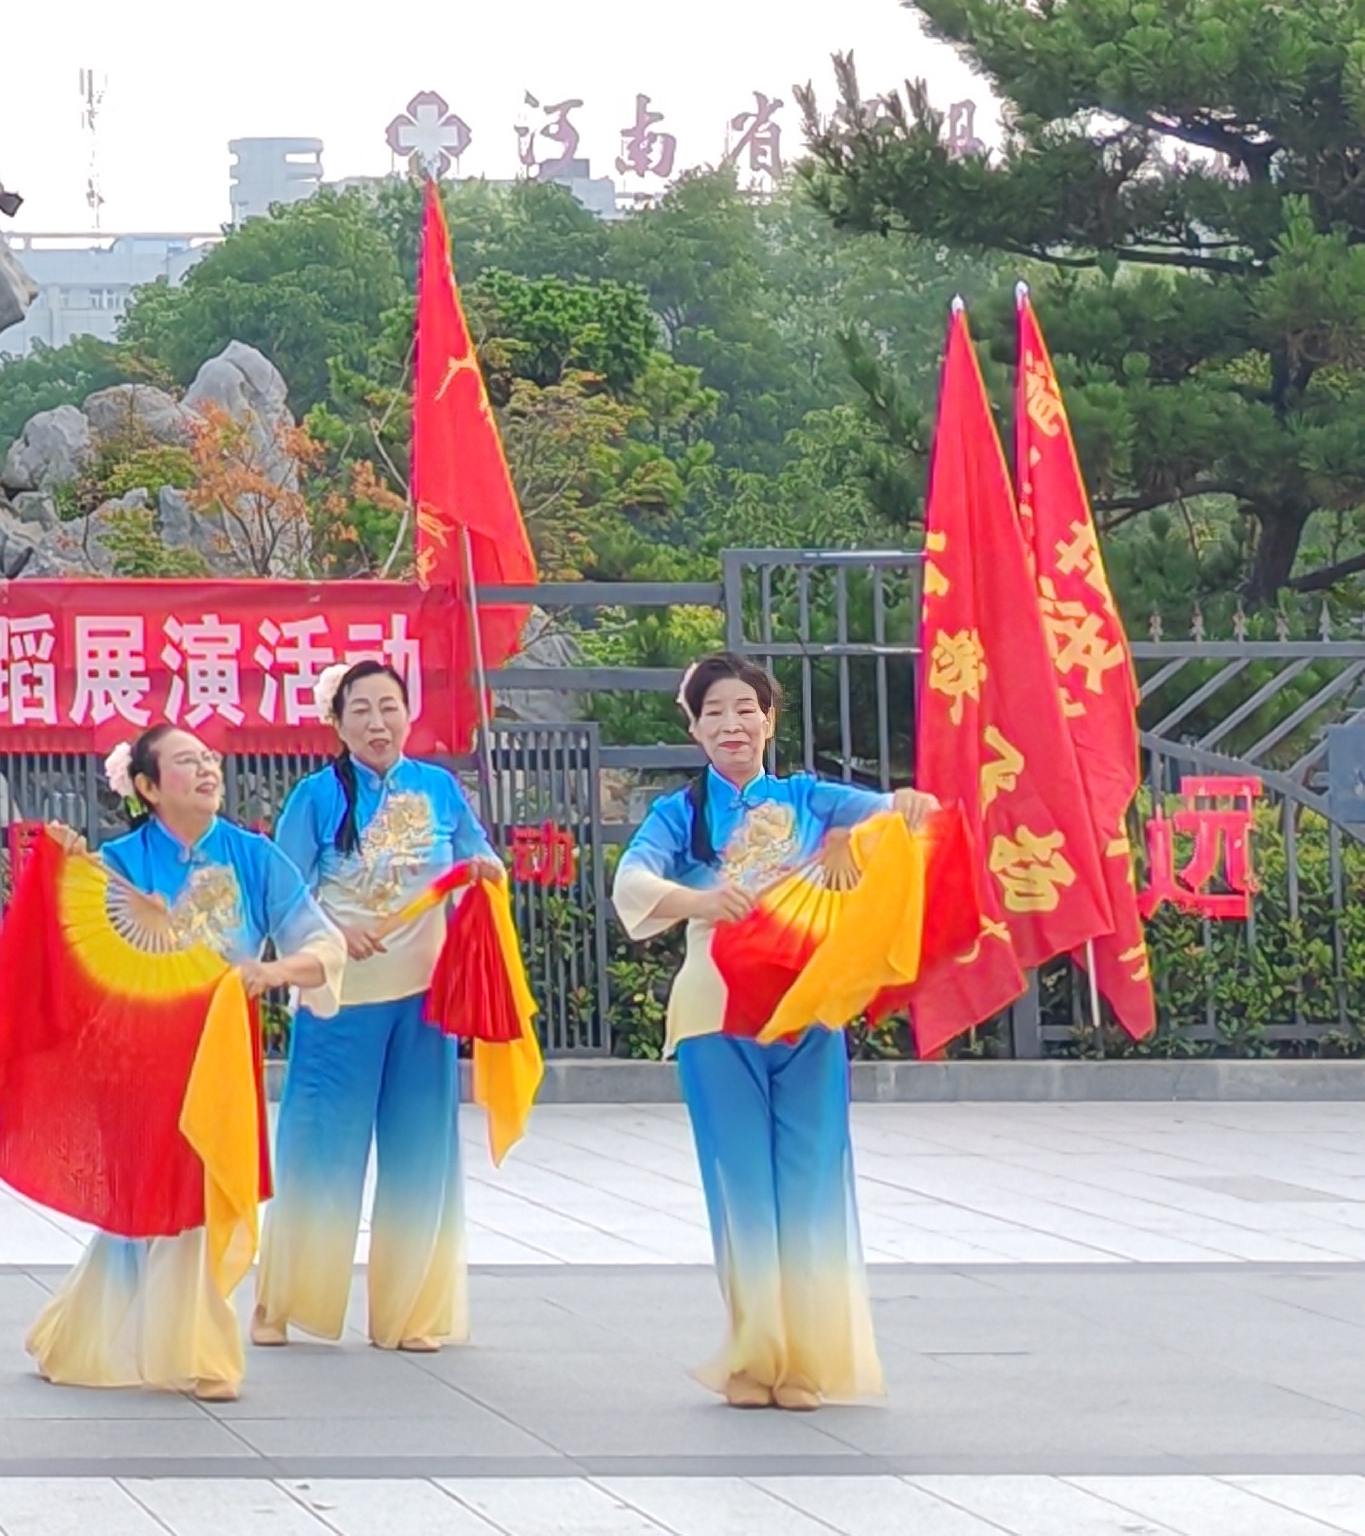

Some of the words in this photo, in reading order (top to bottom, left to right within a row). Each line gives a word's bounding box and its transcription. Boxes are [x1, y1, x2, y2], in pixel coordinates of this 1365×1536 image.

[513, 88, 987, 180] 河南省民
[1136, 775, 1261, 919] 远
